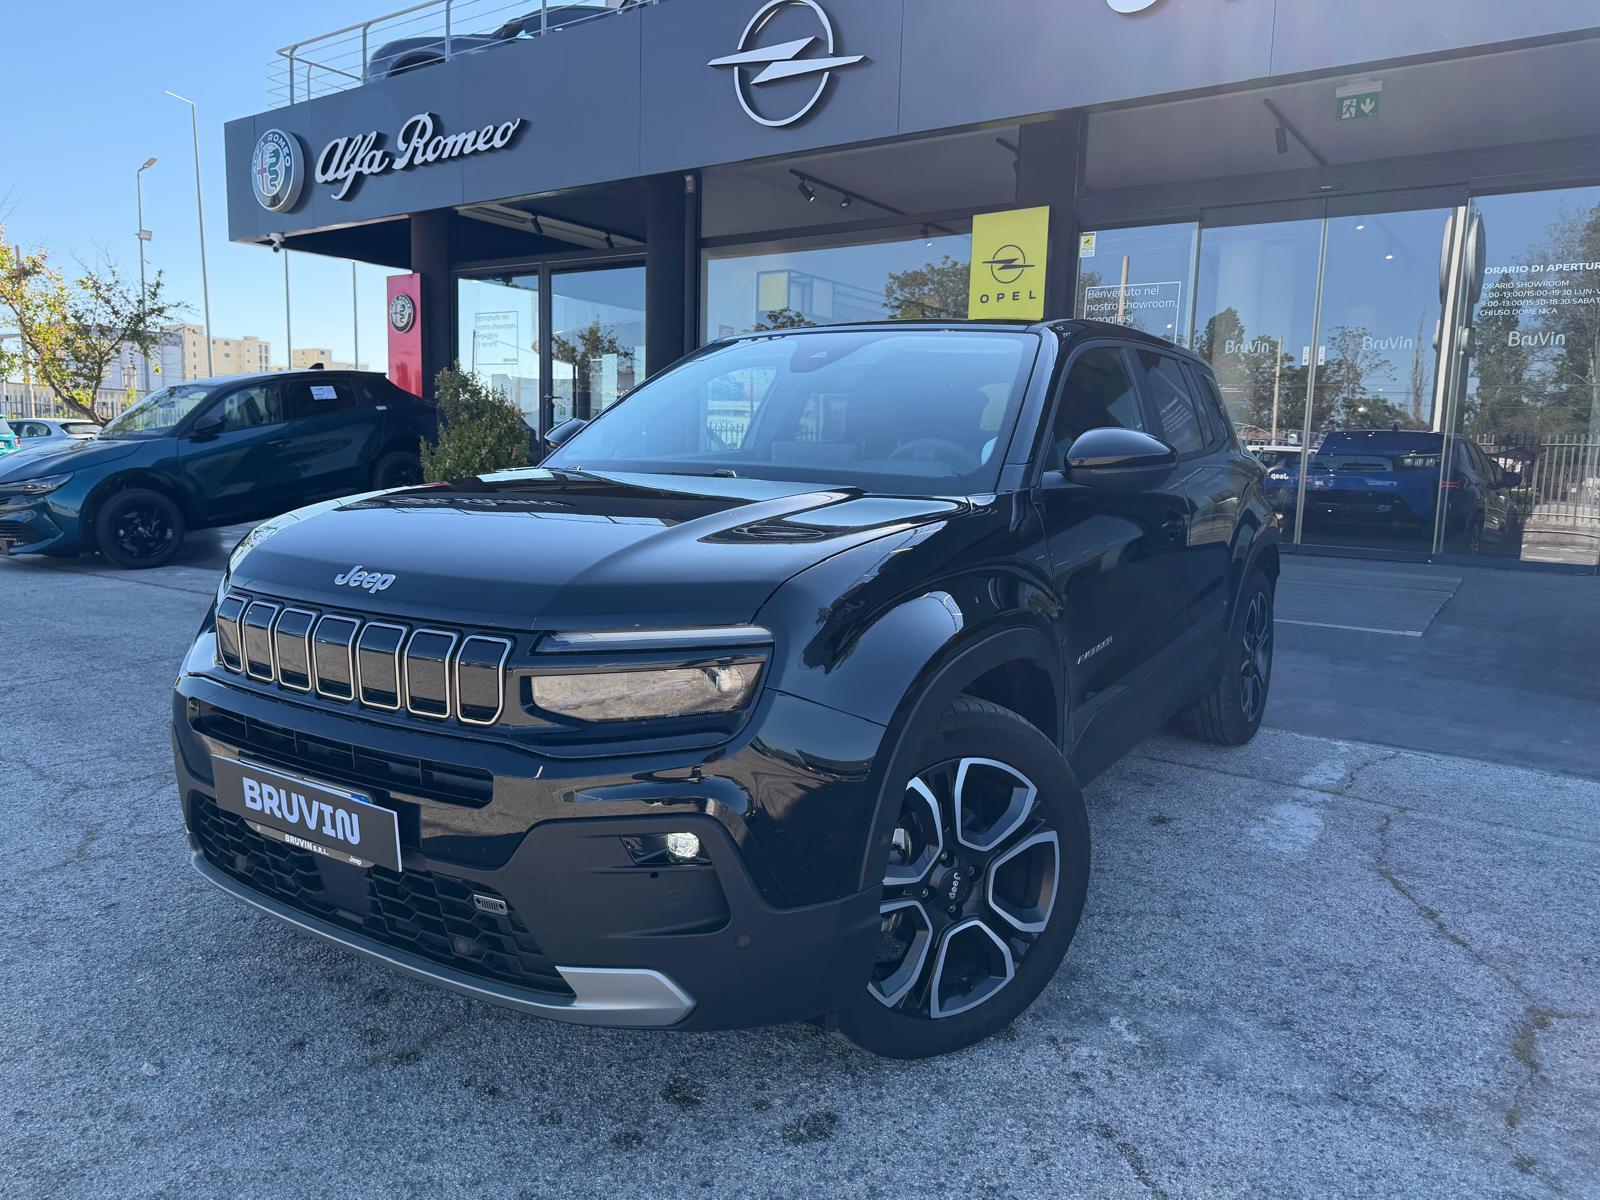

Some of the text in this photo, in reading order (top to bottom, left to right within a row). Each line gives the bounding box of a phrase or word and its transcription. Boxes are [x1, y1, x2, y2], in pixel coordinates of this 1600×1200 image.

[267, 134, 291, 167] ROMEO
[315, 112, 520, 200] Alfa Romeo
[1484, 265, 1528, 274] ORARIO
[1531, 264, 1543, 273] DI
[1144, 285, 1160, 295] nel
[1482, 280, 1569, 290] ORARIO SHOWROOM
[980, 290, 1036, 304] OPEL
[1087, 302, 1118, 311] nostro
[1363, 336, 1412, 350] BruVin
[1508, 331, 1566, 346] BruVin
[1225, 340, 1270, 354] BruVin
[334, 565, 396, 593] Jeep
[242, 777, 360, 845] BRUVIN
[285, 834, 312, 851] BRUVIN
[949, 872, 961, 899] Jeep
